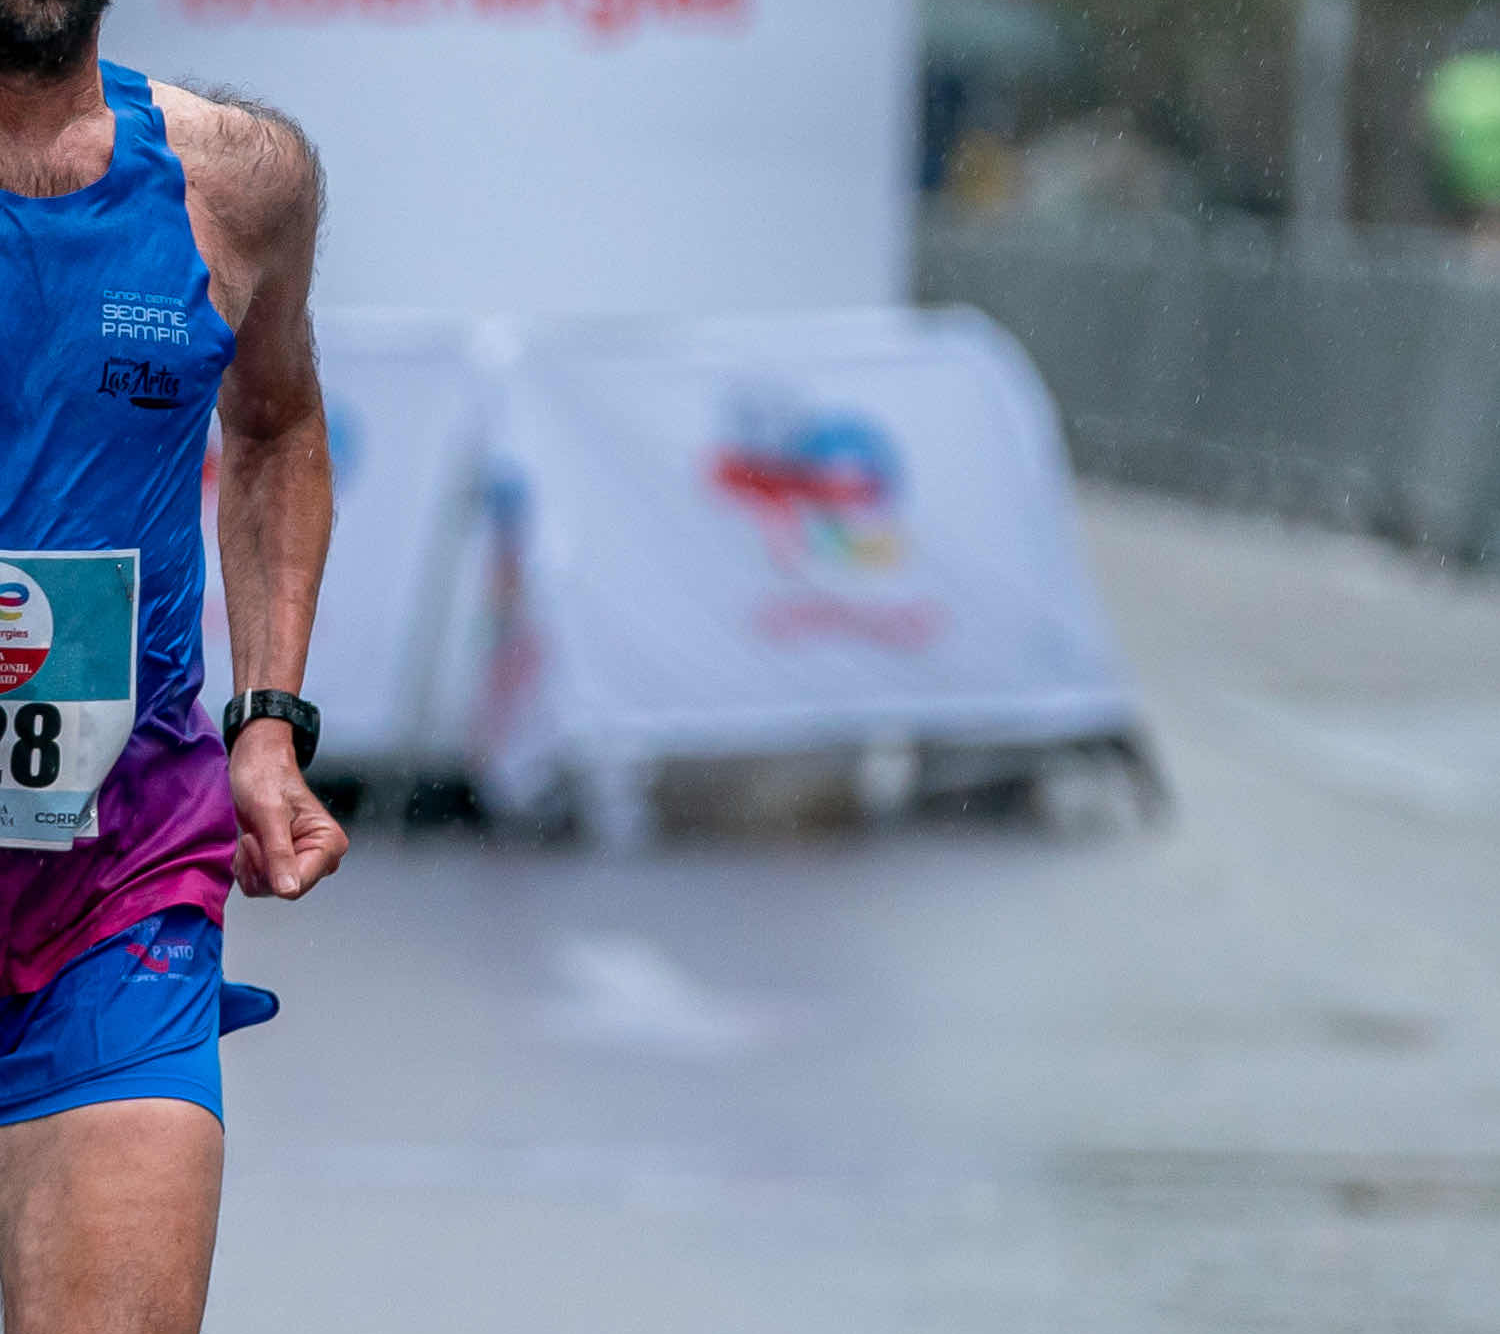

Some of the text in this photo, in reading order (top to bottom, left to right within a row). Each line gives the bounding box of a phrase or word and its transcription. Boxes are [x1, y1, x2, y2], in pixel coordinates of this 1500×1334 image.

[102, 303, 188, 327] SEOANE
[102, 322, 190, 346] PAMPIN
[34, 812, 81, 825] CORR
